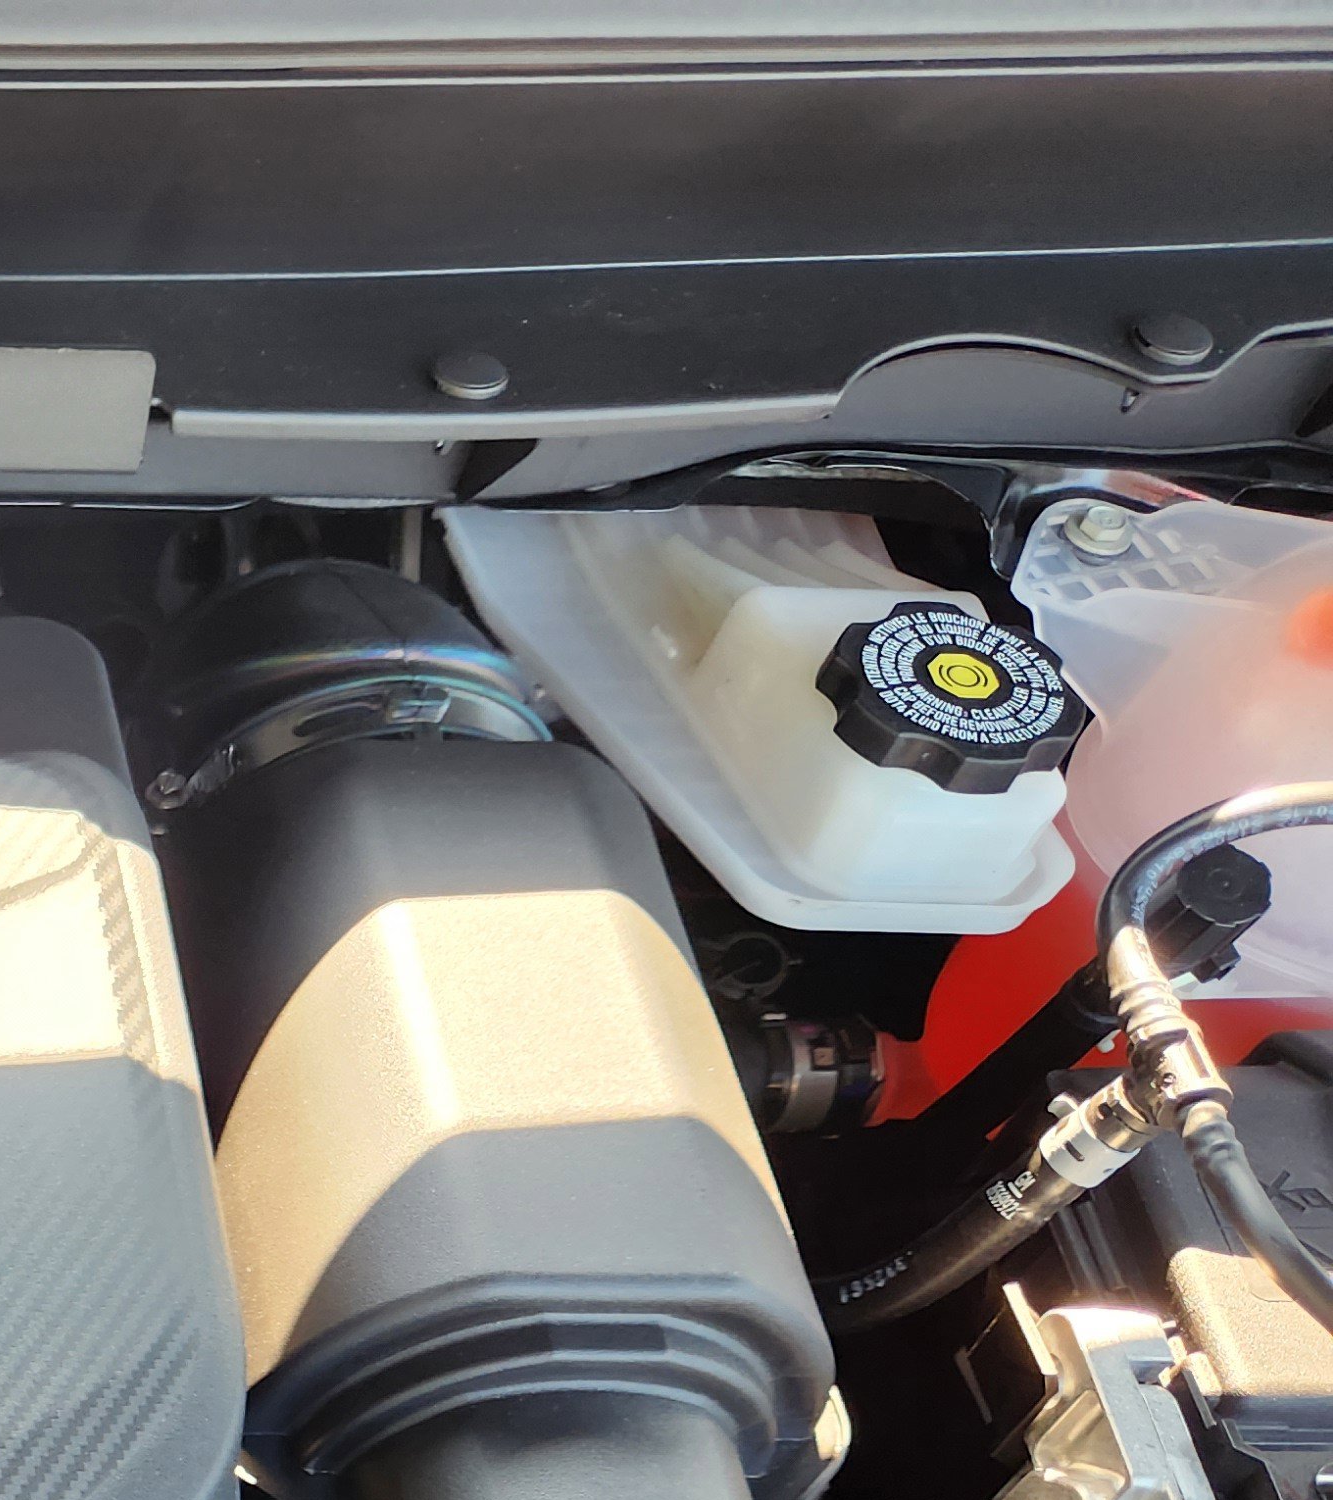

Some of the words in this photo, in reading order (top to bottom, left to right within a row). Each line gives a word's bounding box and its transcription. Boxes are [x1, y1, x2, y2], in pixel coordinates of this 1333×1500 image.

[867, 615, 913, 645] NETTOYER
[910, 612, 928, 624] LE
[928, 611, 985, 631] BOUCHON
[986, 625, 1026, 648] AVANT
[1021, 646, 1040, 660] LA
[915, 624, 934, 636] DU
[934, 623, 981, 640] LIQUIDE
[982, 634, 1000, 647] DE
[922, 634, 953, 646] D'UN
[955, 635, 993, 656] BIDON
[992, 651, 1028, 684] SCELLE
[893, 686, 917, 702] CAP
[912, 699, 959, 727] BEFORE
[1016, 706, 1040, 724] USE
[903, 708, 941, 732] FLUID
[941, 724, 978, 742] FROM
[980, 732, 990, 744] A
[988, 728, 1033, 744] SEALED
